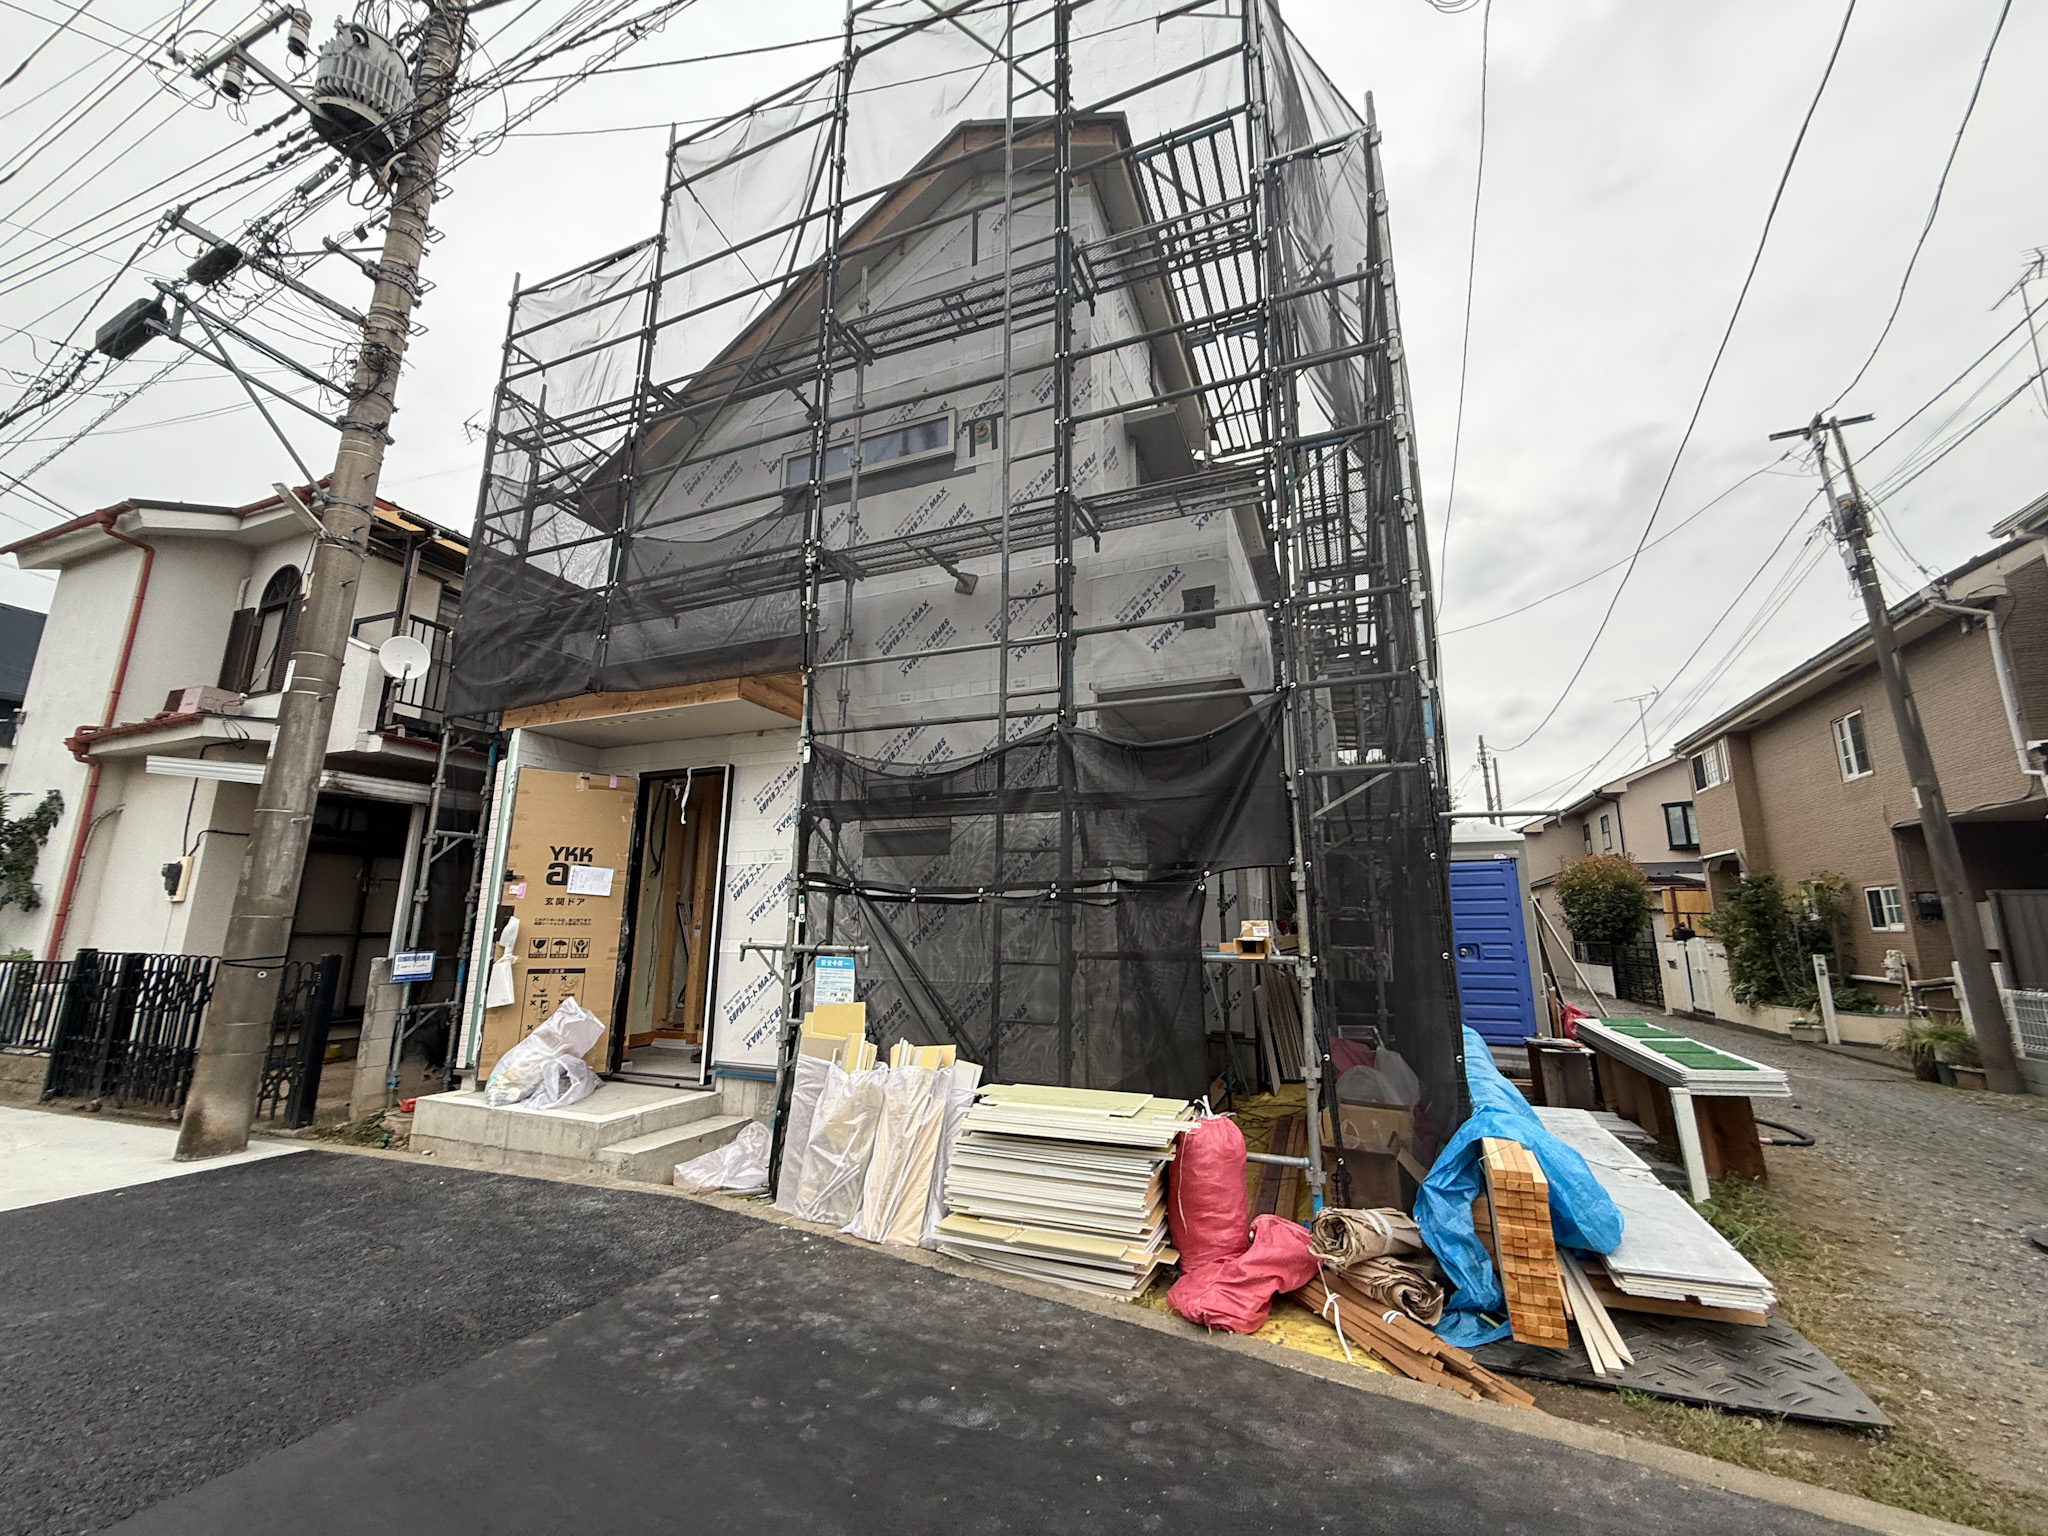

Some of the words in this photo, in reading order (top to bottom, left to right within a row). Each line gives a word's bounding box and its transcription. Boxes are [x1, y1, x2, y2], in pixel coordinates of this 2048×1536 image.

[549, 845, 594, 863] YKK
[544, 897, 586, 906] 玄関ドア
